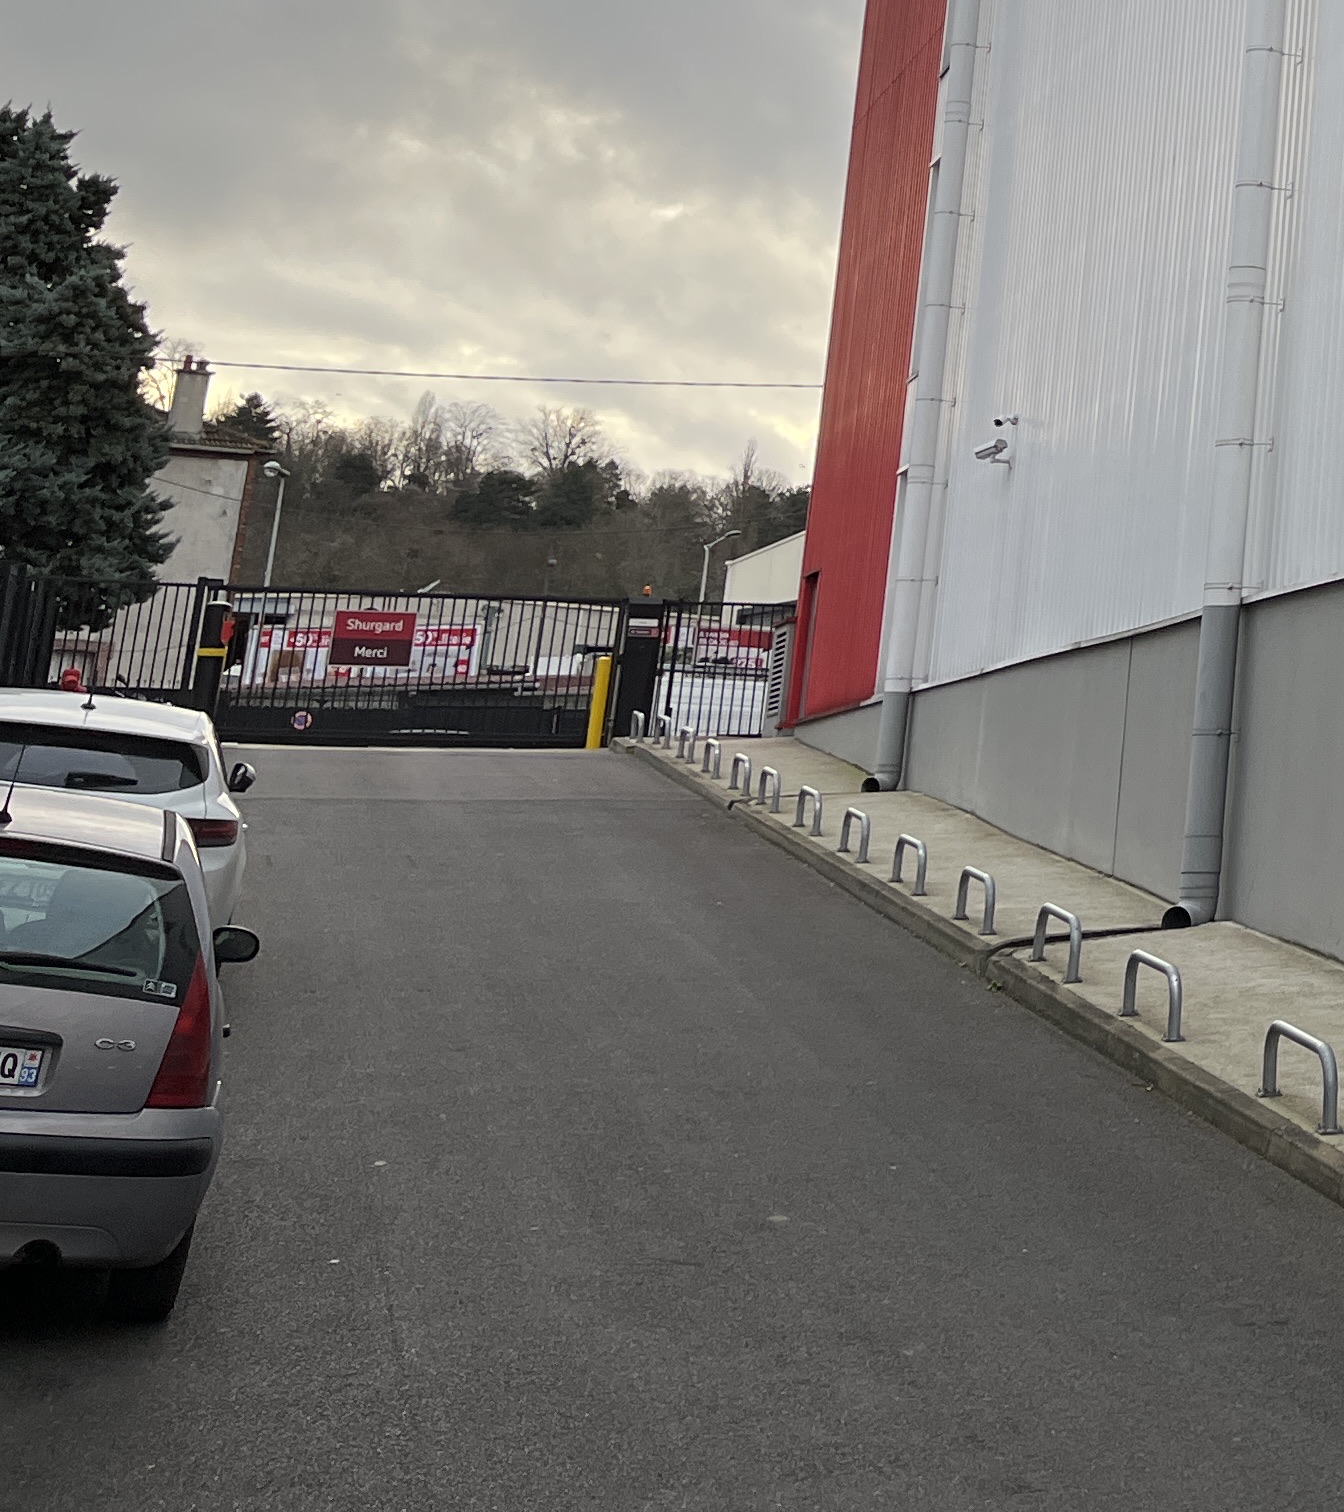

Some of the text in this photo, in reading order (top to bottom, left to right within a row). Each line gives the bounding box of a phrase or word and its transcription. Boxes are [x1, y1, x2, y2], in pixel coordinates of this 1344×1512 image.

[346, 618, 404, 634] Shurgard
[354, 646, 388, 658] Merci
[94, 1037, 137, 1051] C3
[0, 1052, 18, 1079] Q
[20, 1069, 37, 1083] 93
